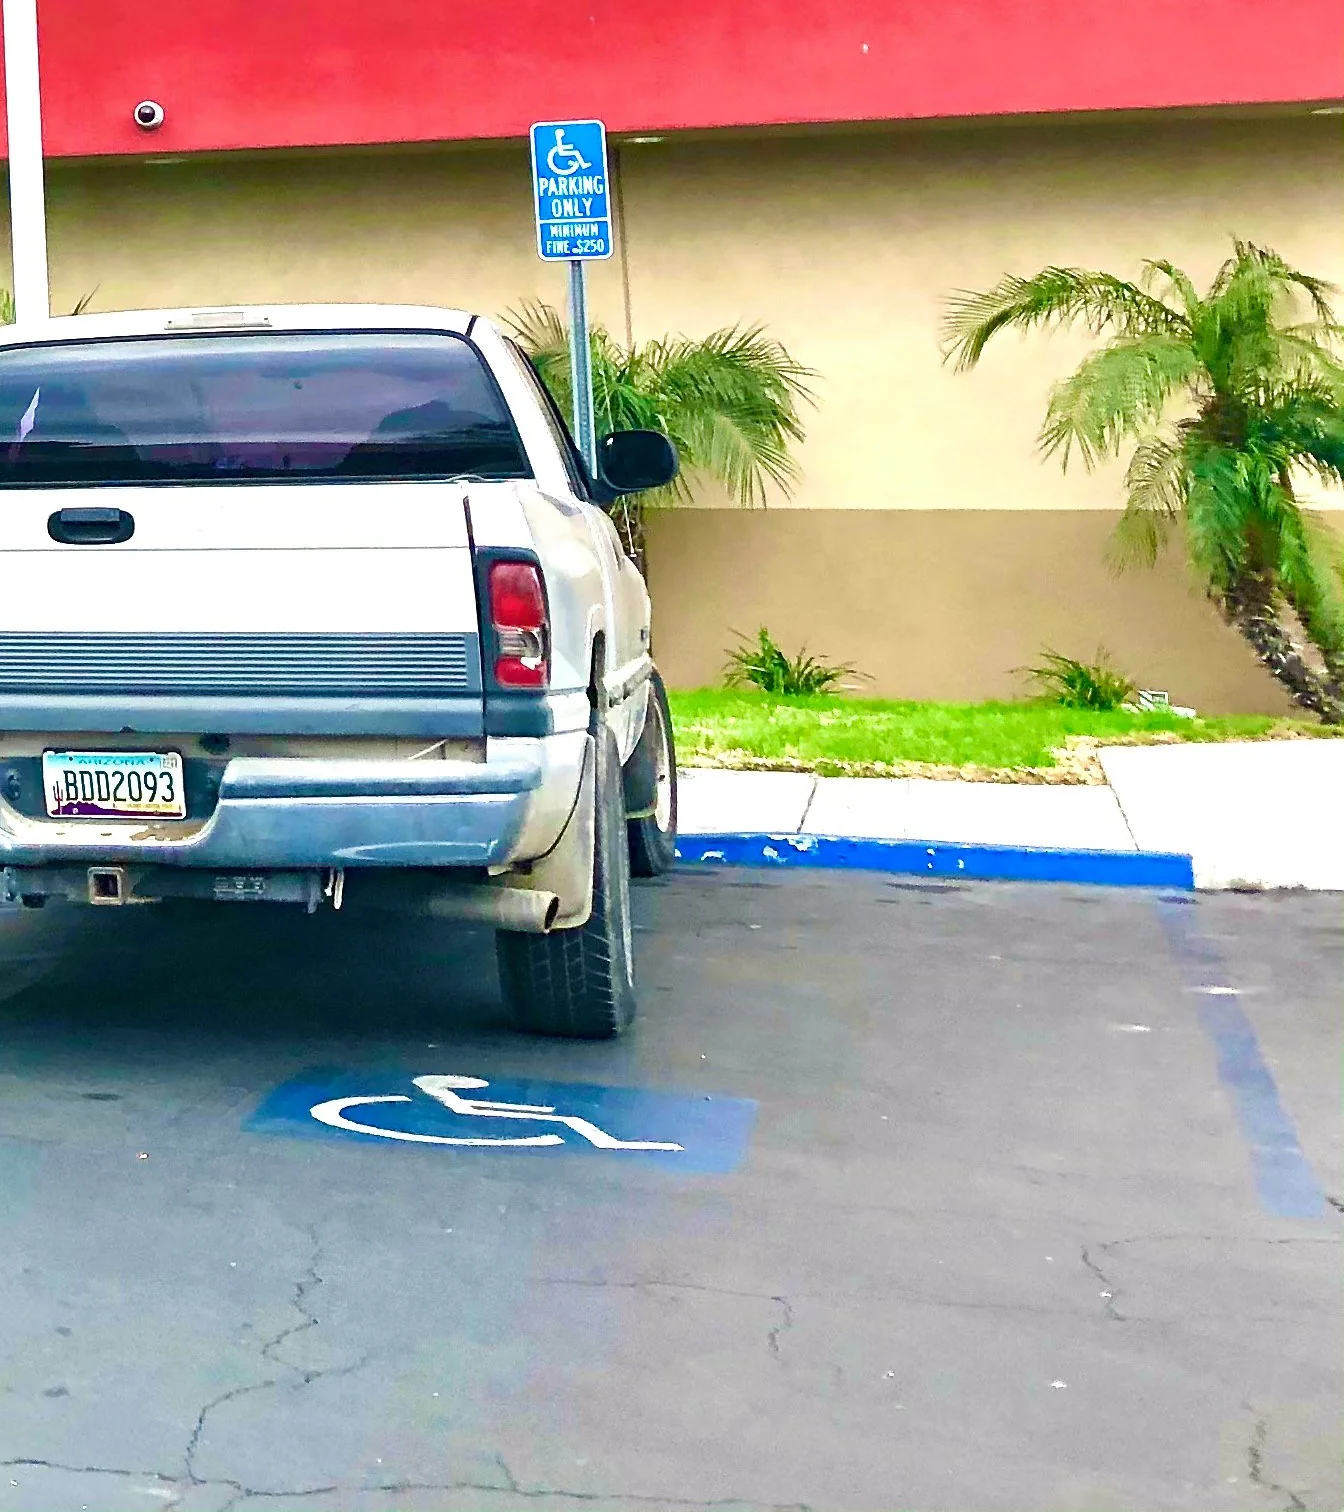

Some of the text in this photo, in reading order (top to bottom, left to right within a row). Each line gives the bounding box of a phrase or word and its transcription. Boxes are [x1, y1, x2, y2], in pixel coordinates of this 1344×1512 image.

[539, 175, 604, 196] PARKING
[551, 197, 593, 217] ONLY
[550, 223, 599, 238] MINIMUM
[546, 238, 605, 254] FINE $250
[62, 769, 175, 803] BDD2093
